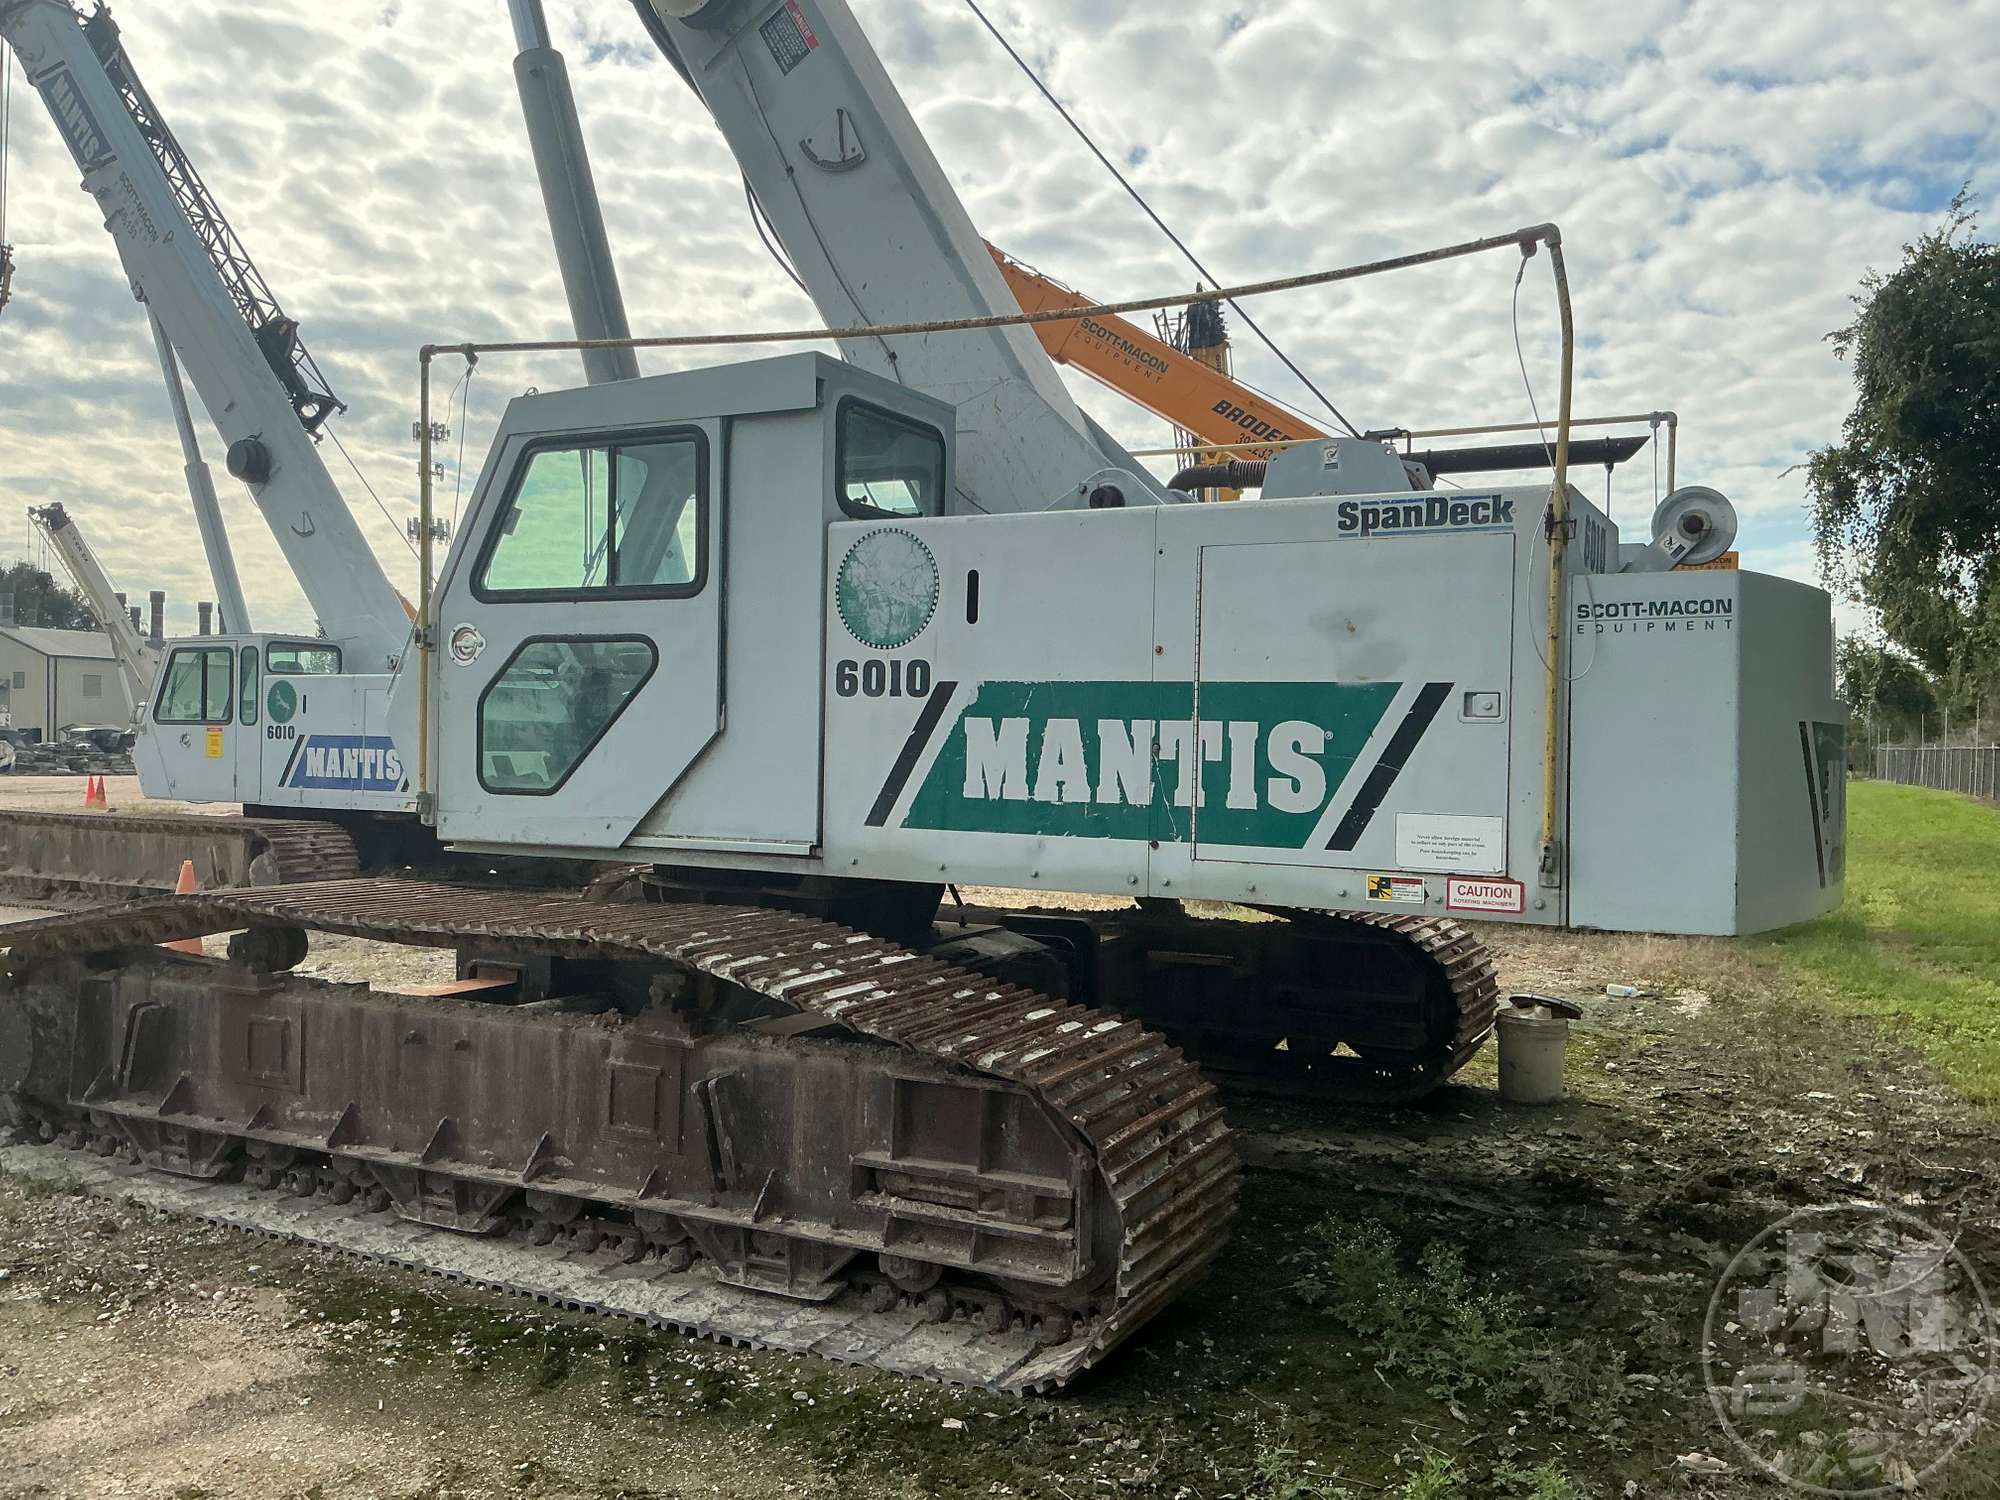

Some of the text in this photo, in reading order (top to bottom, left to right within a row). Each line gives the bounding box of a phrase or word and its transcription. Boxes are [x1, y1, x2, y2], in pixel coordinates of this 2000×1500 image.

[51, 74, 100, 160] MANTIS
[1073, 331, 1161, 384] EQUIPMENT
[1080, 317, 1169, 373] SCOTT-MACON
[1338, 494, 1514, 537] SpanDeck
[1577, 598, 1733, 619] SCOTT-MACON
[1577, 619, 1733, 635] EQUIPMENT
[836, 659, 931, 698] 6010
[267, 725, 295, 740] 6010
[306, 747, 402, 781] MANTIS
[964, 716, 1327, 814] MANTIS
[1457, 884, 1513, 899] CAUTION
[1482, 900, 1516, 908] MACHINERY
